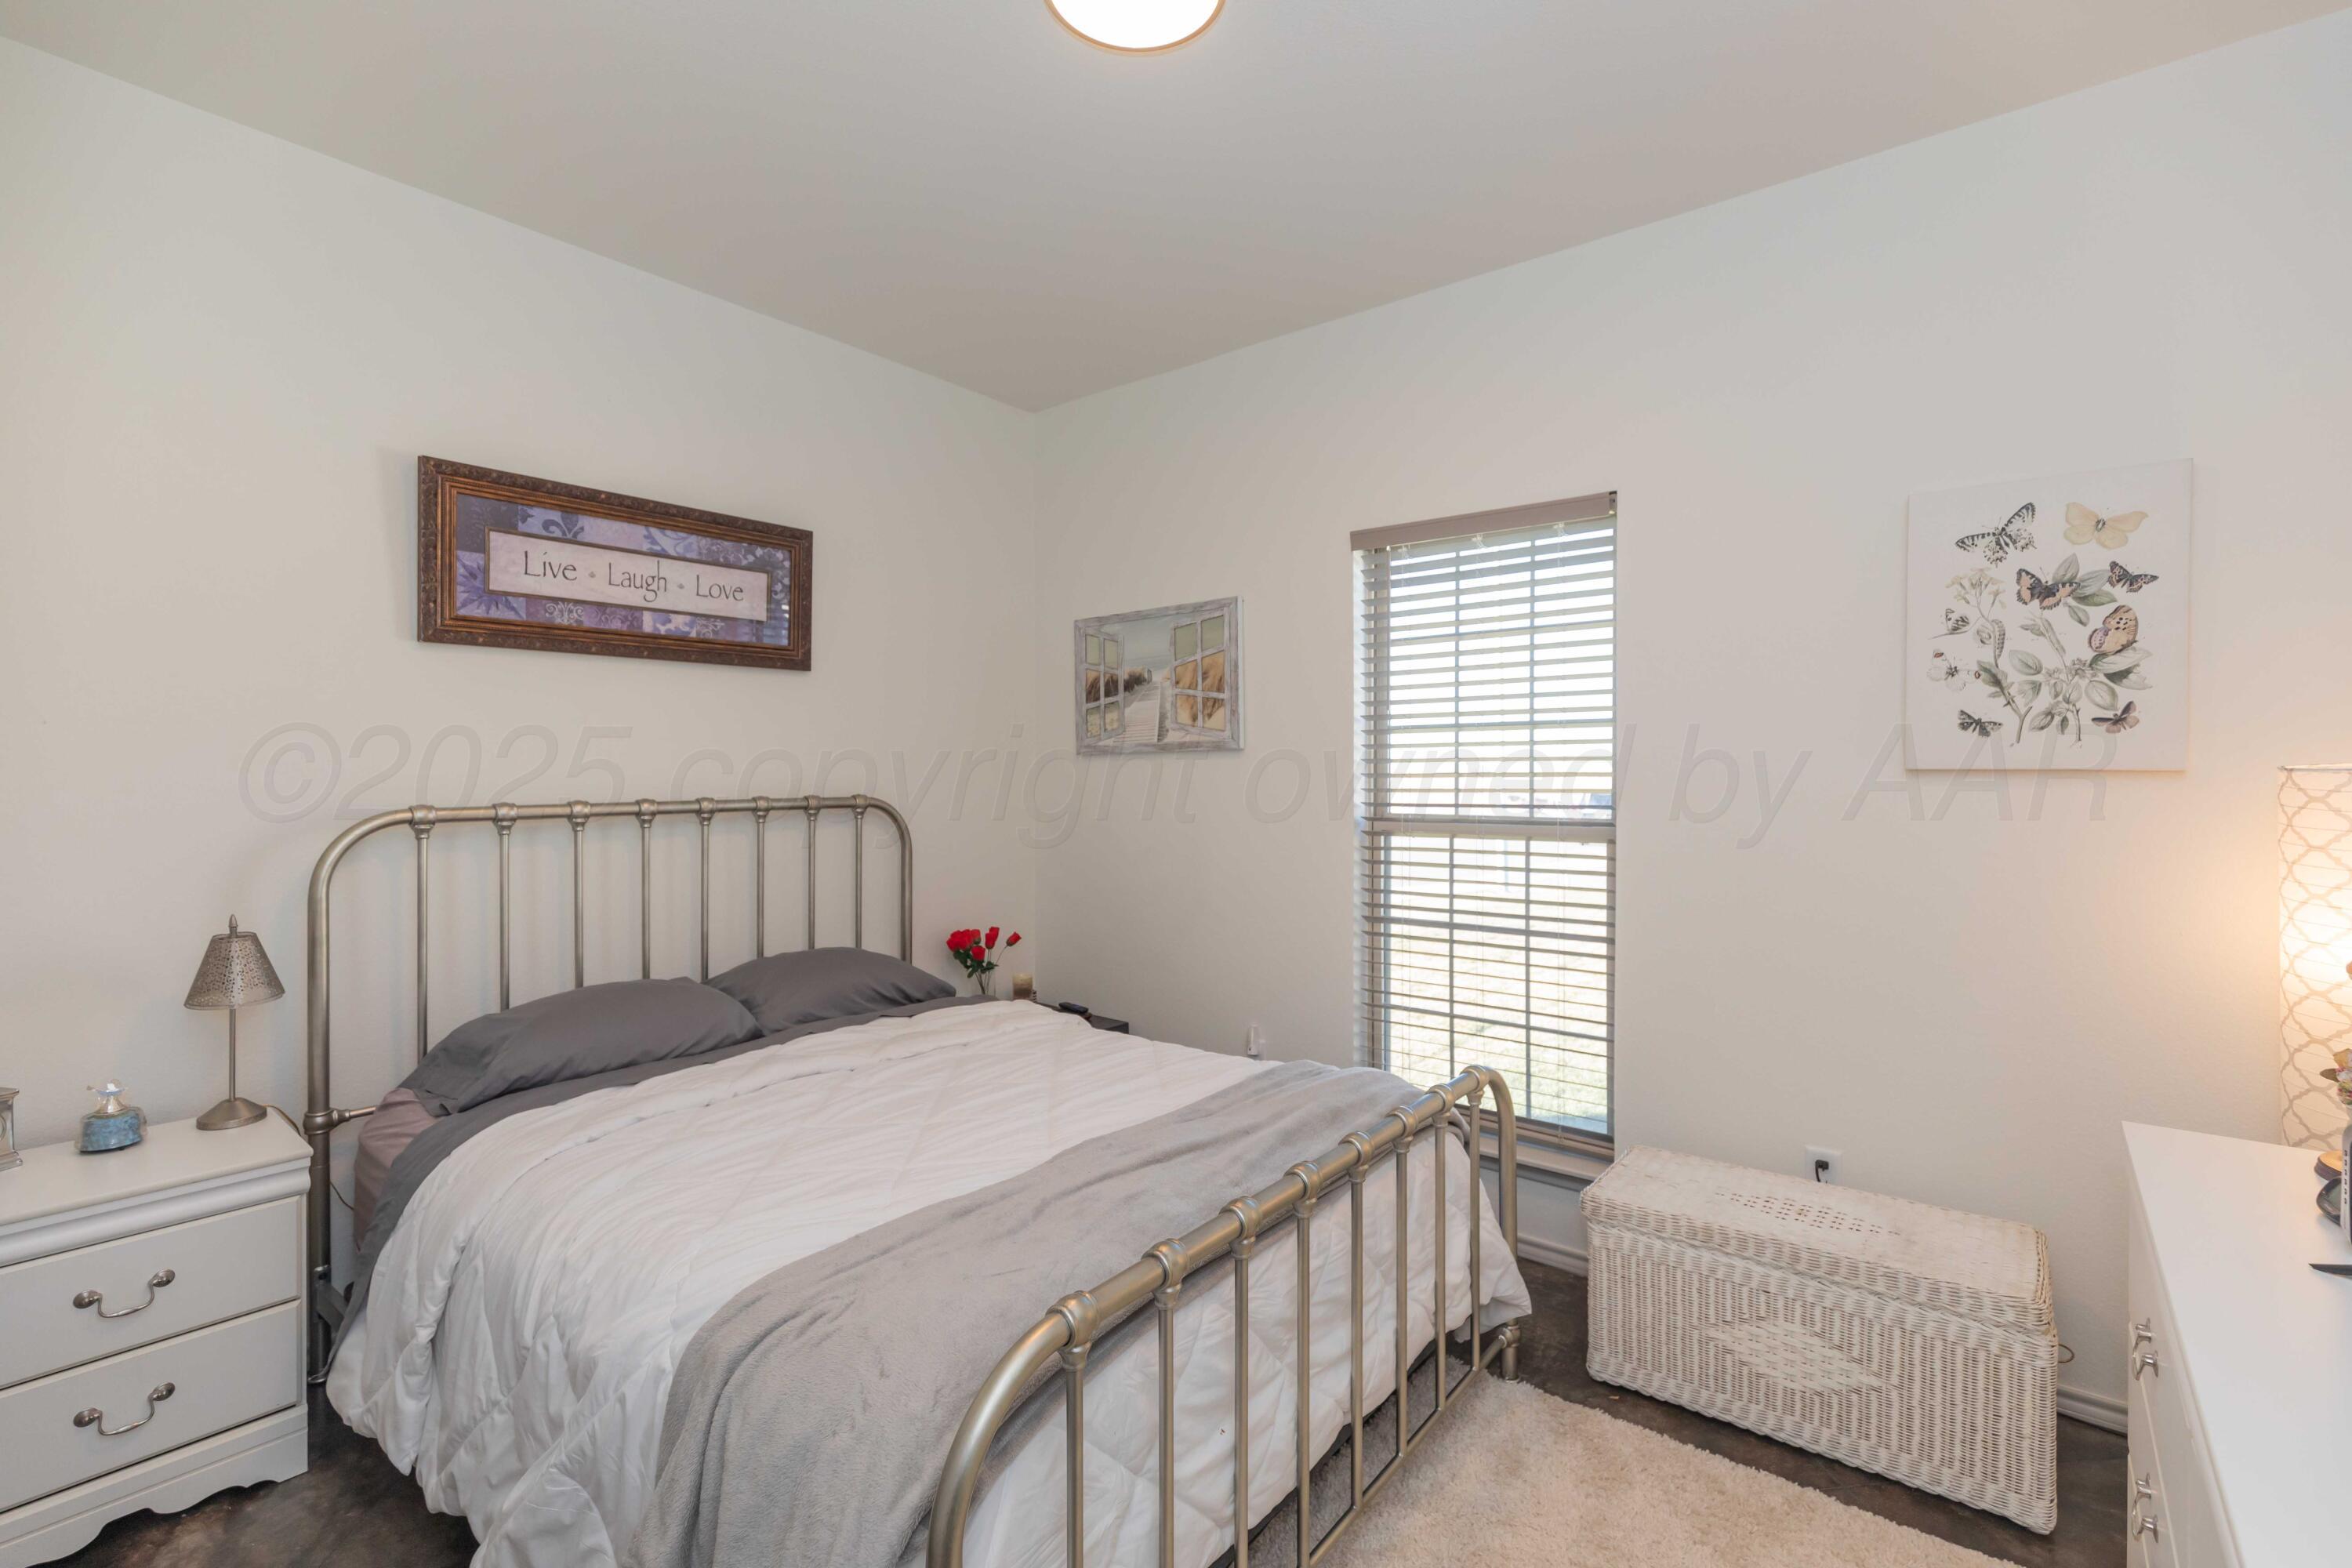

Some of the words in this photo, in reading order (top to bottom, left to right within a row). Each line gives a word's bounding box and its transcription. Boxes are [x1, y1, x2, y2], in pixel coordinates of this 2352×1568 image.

[524, 550, 578, 581] Live
[608, 560, 667, 603] Laugh
[695, 574, 745, 602] Love
